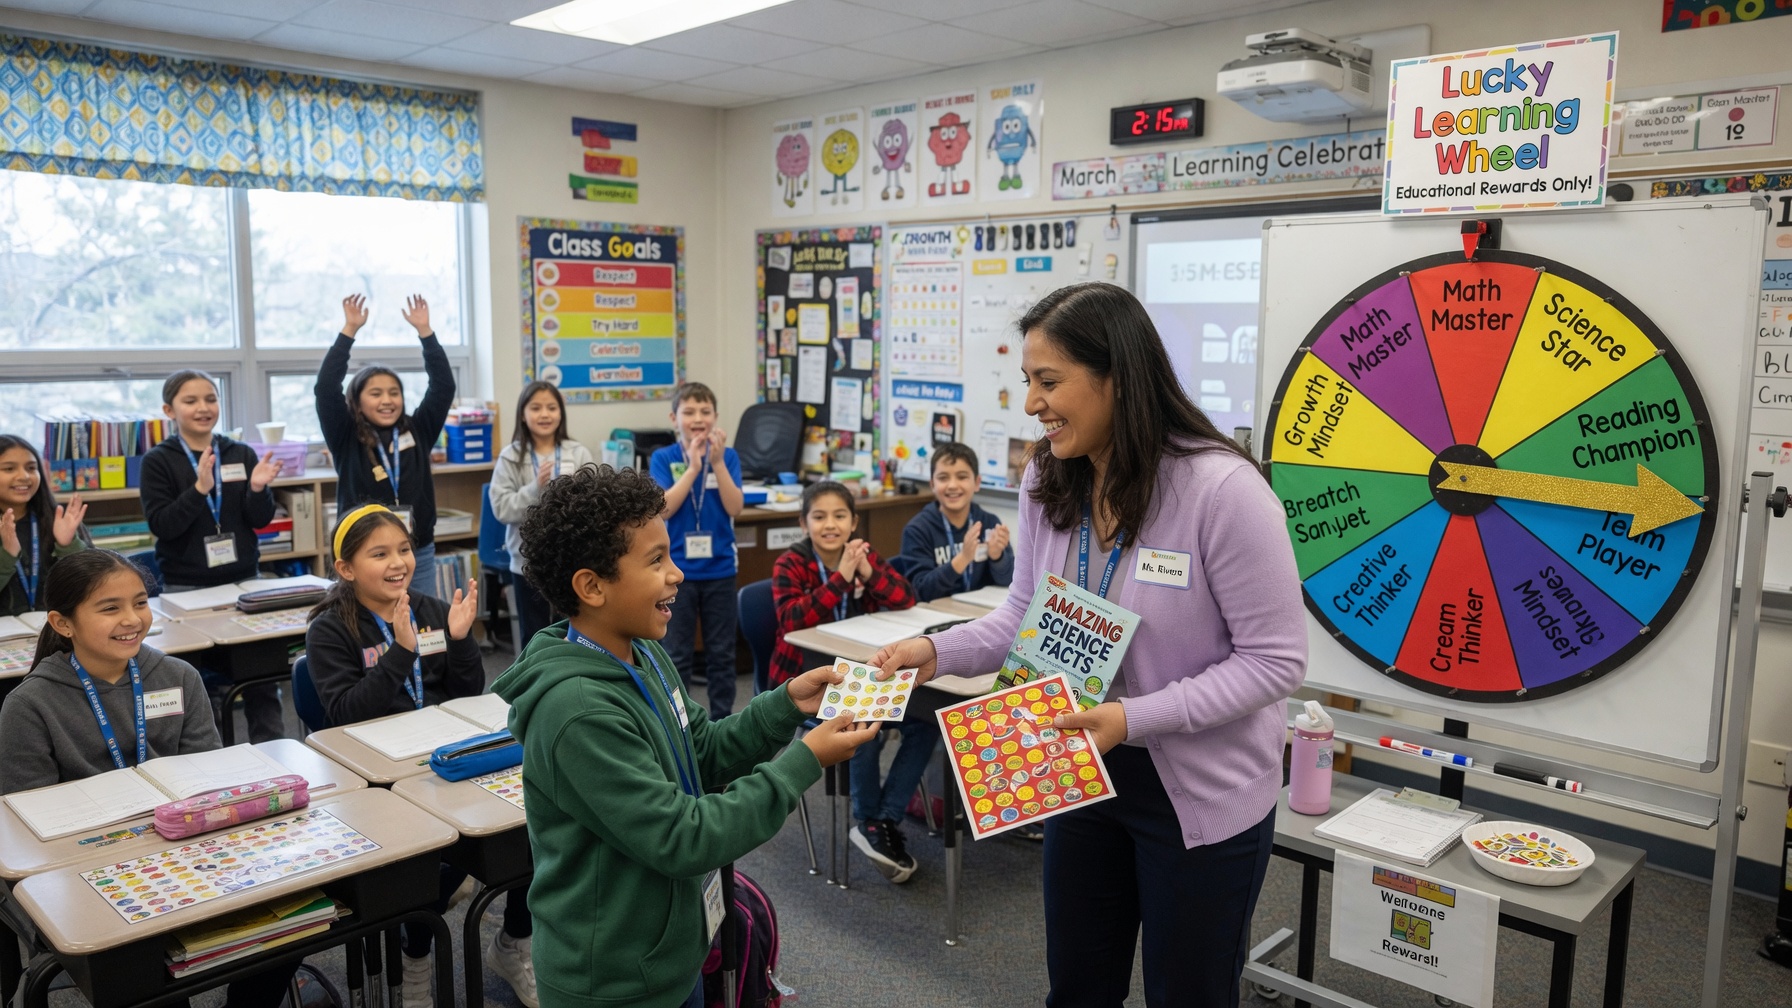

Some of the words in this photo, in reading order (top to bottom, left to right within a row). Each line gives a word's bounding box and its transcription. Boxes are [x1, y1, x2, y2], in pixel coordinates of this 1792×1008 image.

[1442, 58, 1554, 98] Lucky
[1131, 107, 1174, 135] 2:15
[1414, 97, 1580, 138] Learning
[1061, 163, 1117, 187] March
[1173, 151, 1268, 177] Learning
[1435, 134, 1550, 175] Wheel
[1396, 182, 1476, 200] Educational
[1480, 178, 1547, 196] Rewards
[1552, 175, 1592, 193] Only!
[548, 232, 602, 257] Class
[608, 235, 661, 260] Goals
[1443, 278, 1501, 302] Math
[1340, 307, 1392, 351] Math
[1431, 308, 1514, 331] Master
[1543, 293, 1627, 362] Science
[1347, 322, 1412, 380] Master
[1541, 330, 1592, 372] Star
[1284, 374, 1329, 446] Growth
[1306, 381, 1353, 459] Mindset
[1578, 398, 1681, 438] Reading
[1572, 428, 1696, 469] Champion
[1283, 481, 1360, 519] Breatch
[1577, 533, 1661, 580] Player
[1333, 544, 1397, 613] Creative
[1355, 564, 1412, 627] Thinker
[1039, 612, 1114, 661] SCIENCE
[1044, 593, 1124, 643] AMAZING
[1430, 603, 1456, 672] Cream
[1458, 587, 1484, 665] Thinker
[1513, 579, 1580, 660] Mindset
[1040, 635, 1094, 674] FACTS
